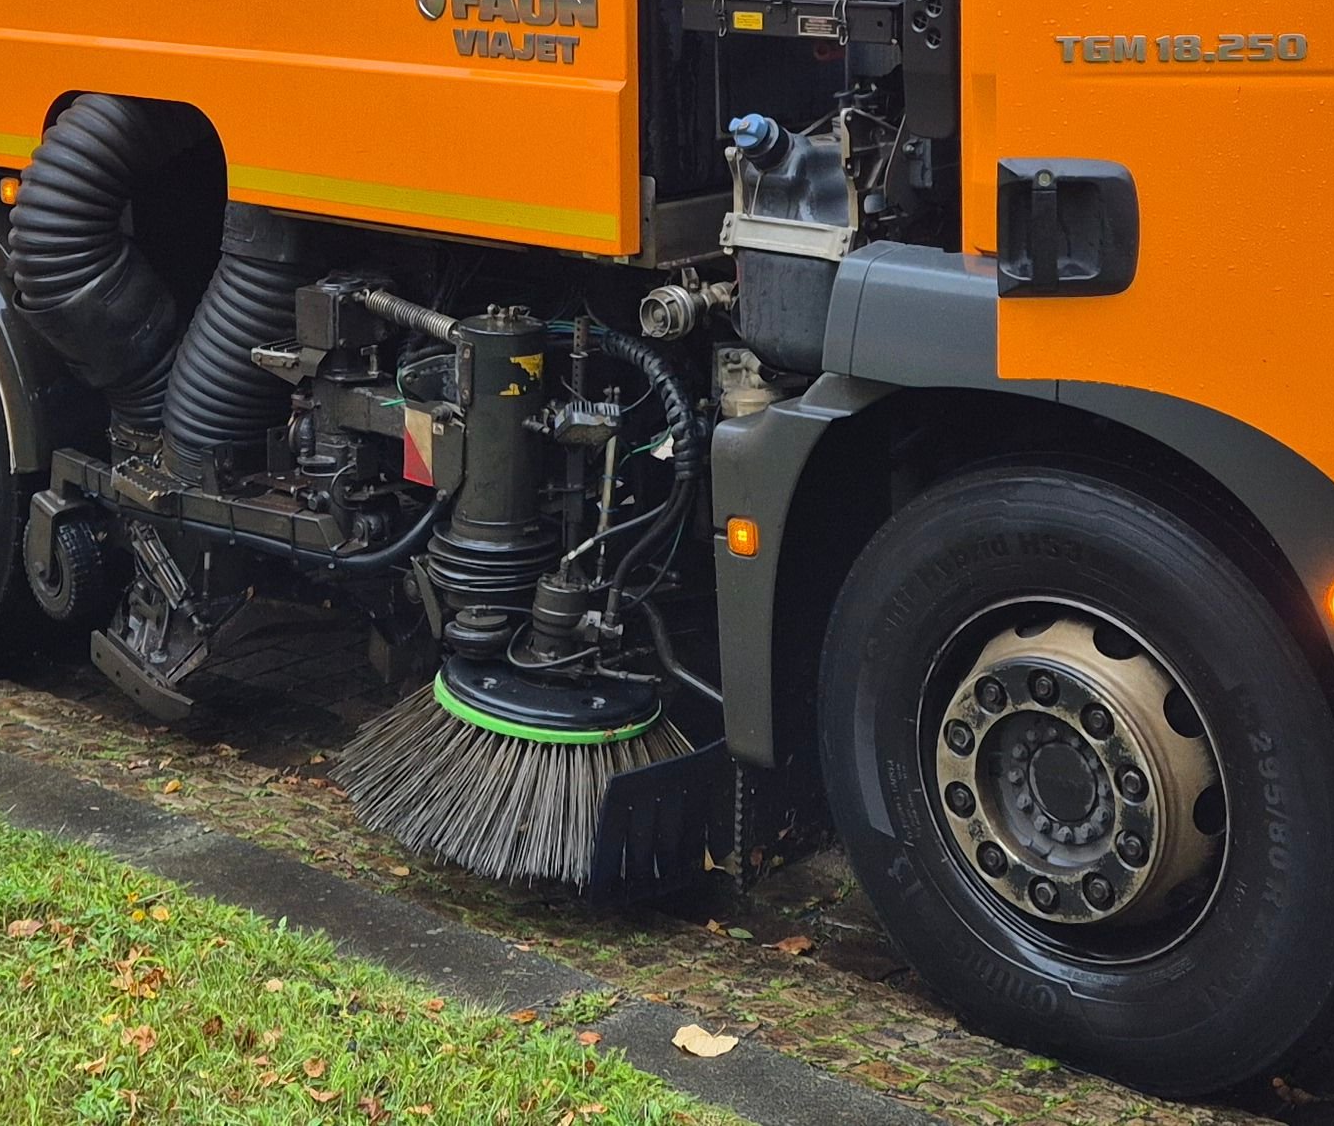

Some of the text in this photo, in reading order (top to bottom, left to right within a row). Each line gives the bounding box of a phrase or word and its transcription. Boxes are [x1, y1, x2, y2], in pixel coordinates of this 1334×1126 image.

[452, 28, 580, 64] VIAJET
[1055, 33, 1308, 63] TGM 18.250
